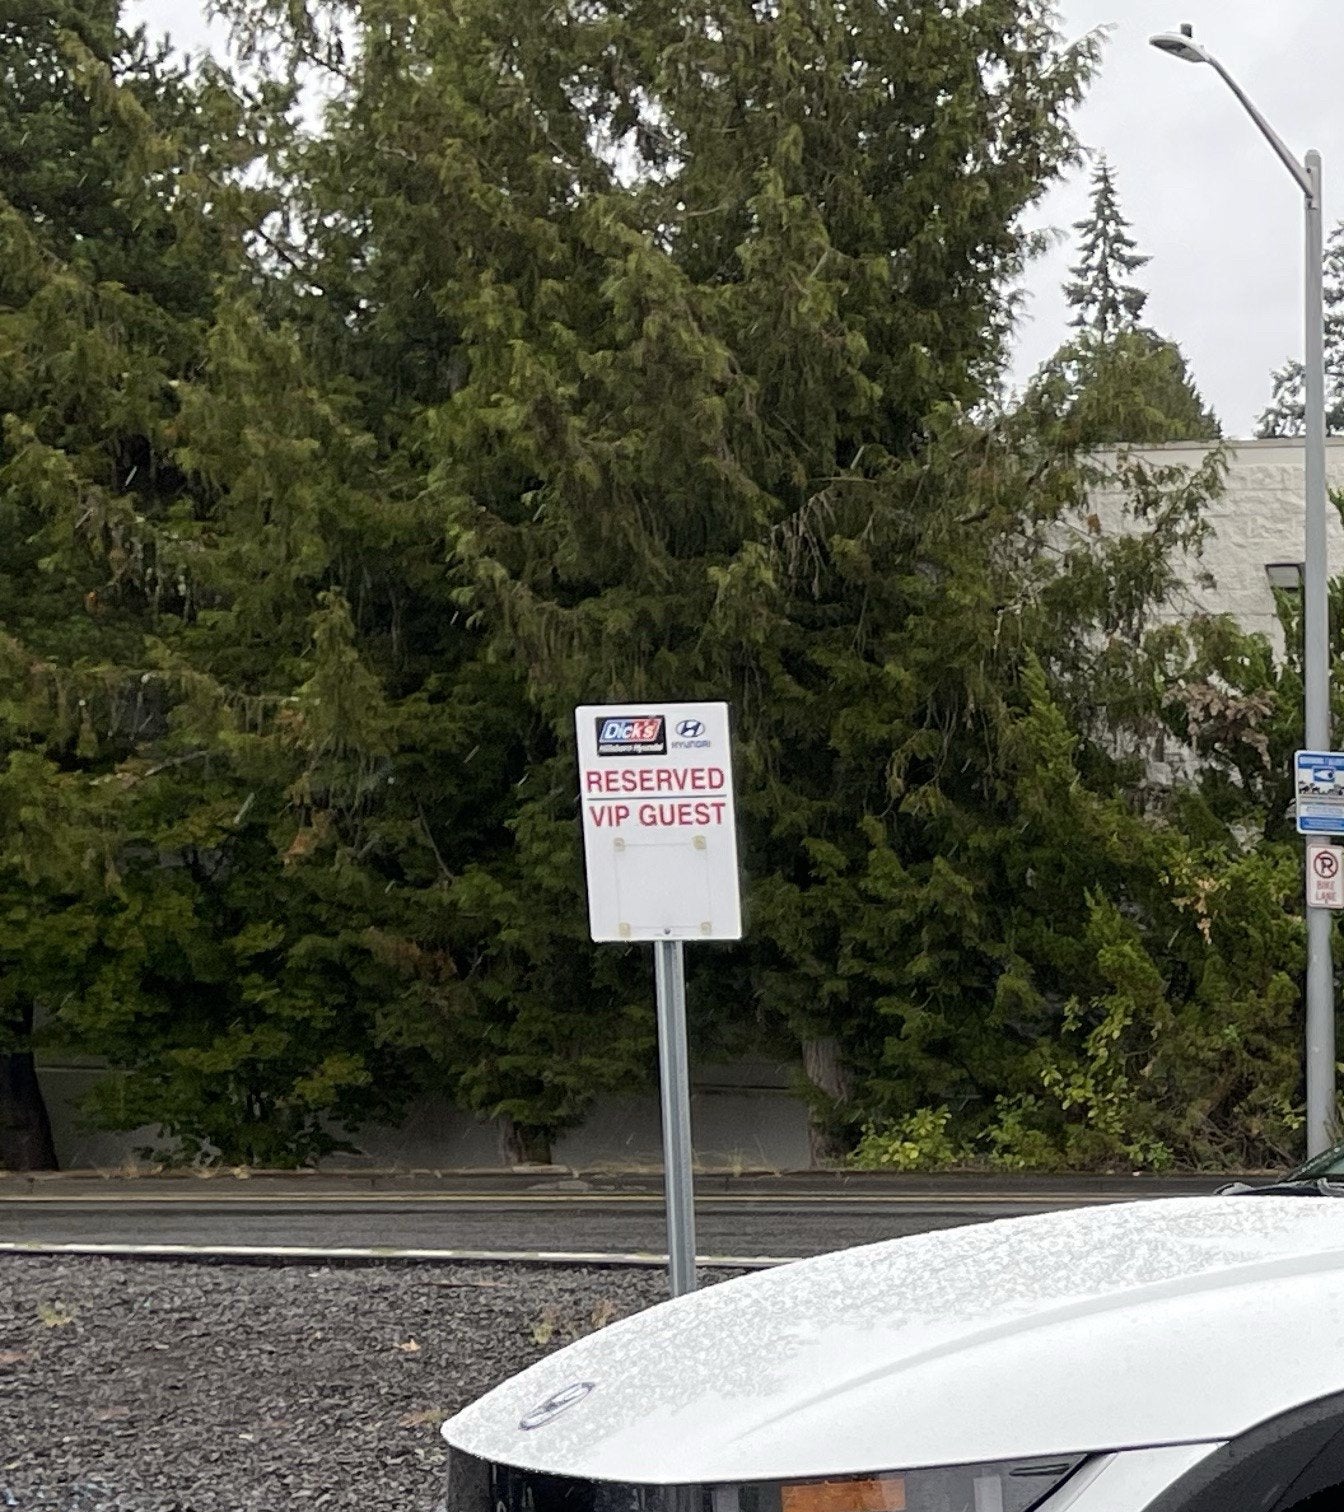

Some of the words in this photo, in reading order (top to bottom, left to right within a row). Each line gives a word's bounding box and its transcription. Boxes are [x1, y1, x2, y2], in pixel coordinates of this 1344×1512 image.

[604, 719, 655, 739] Dick's
[586, 768, 725, 793] RESERVED
[589, 805, 630, 827] VIP
[638, 802, 726, 826] GUEST
